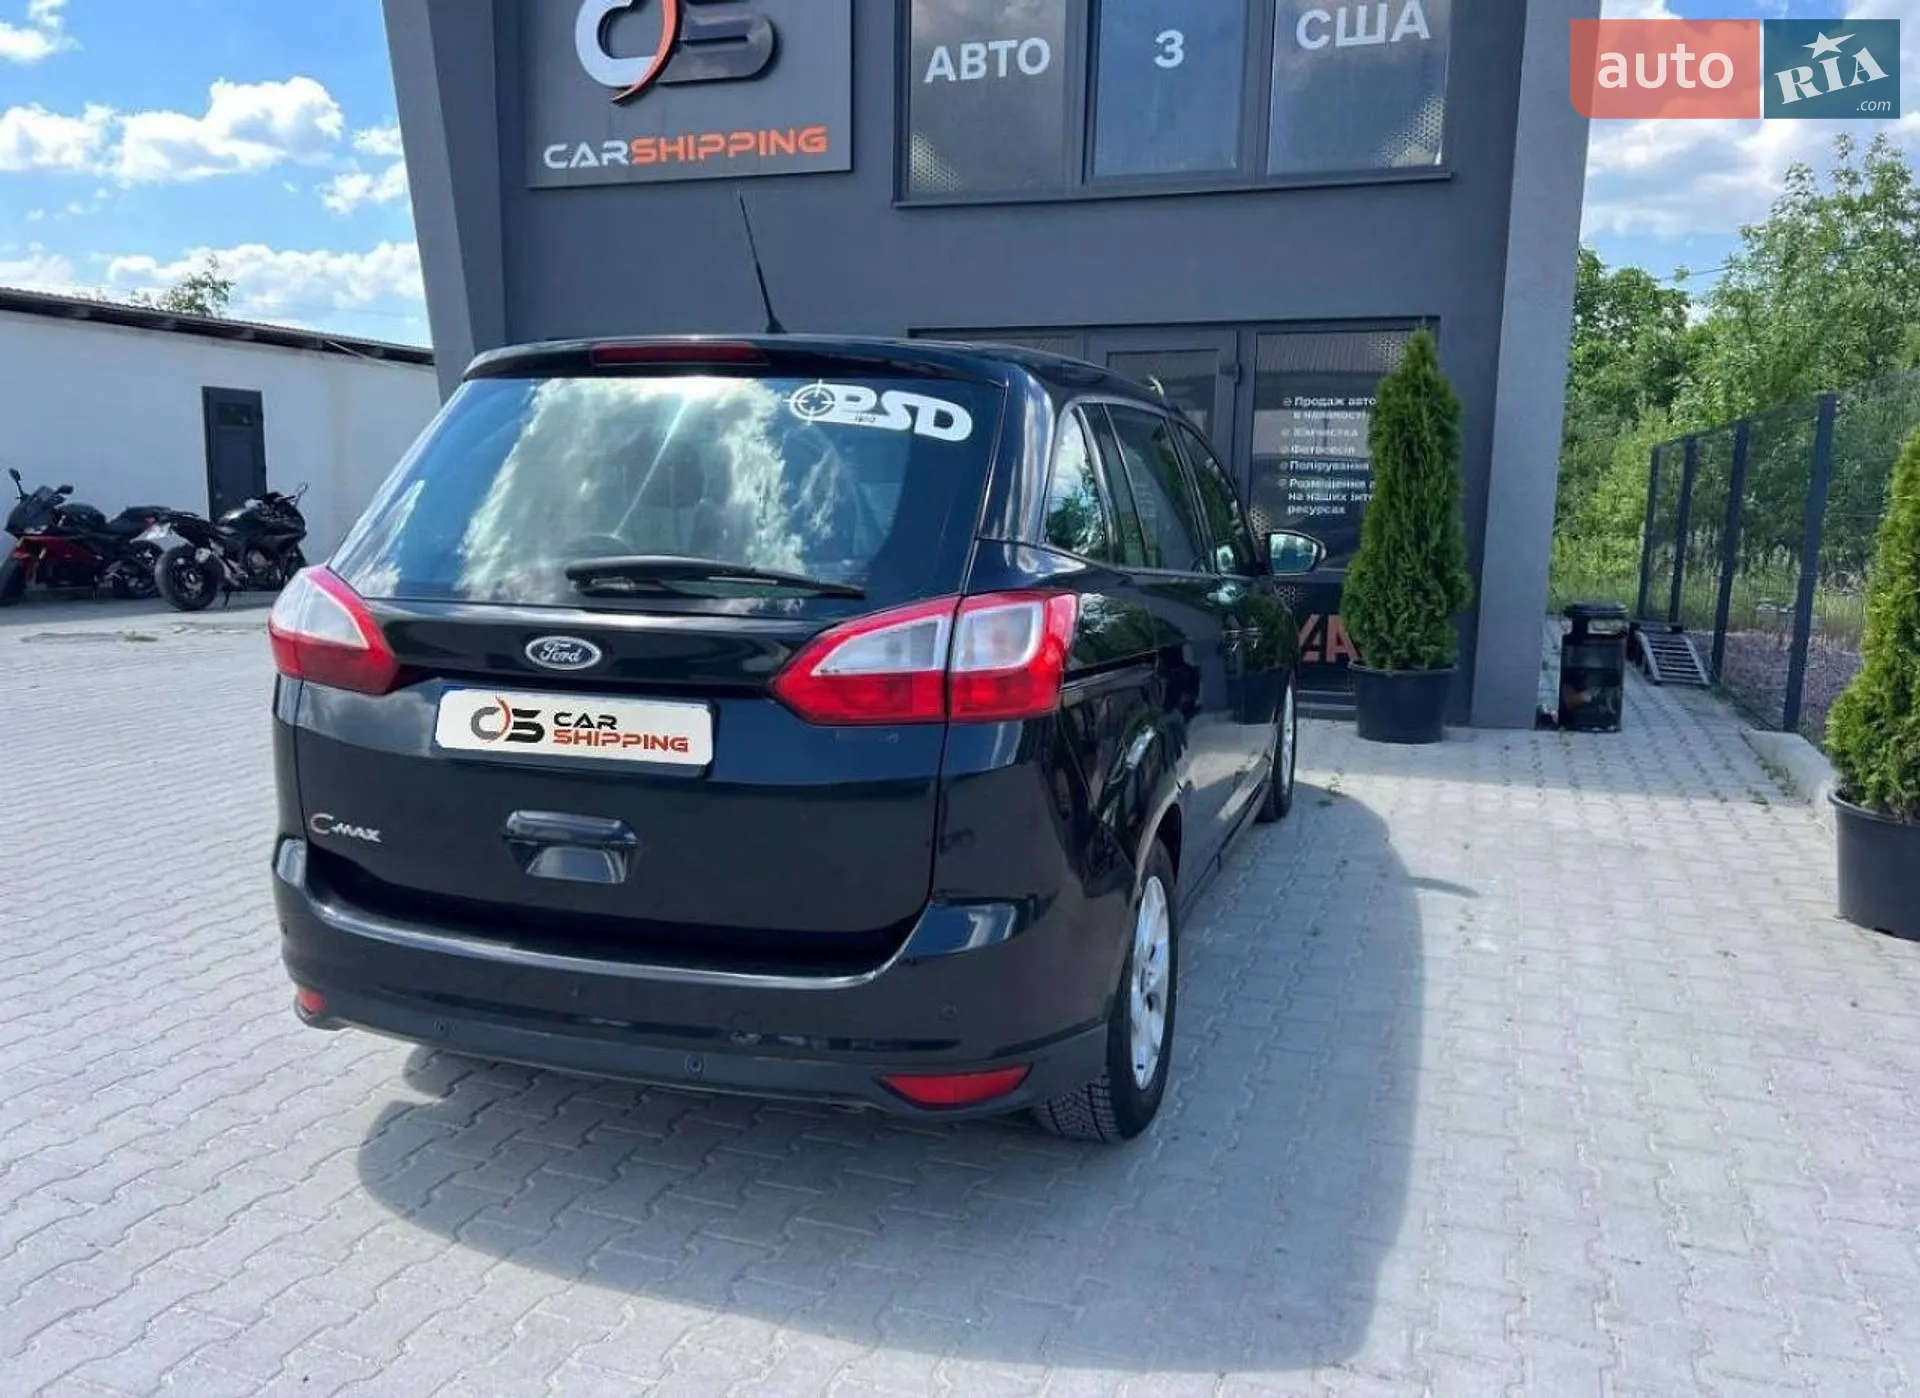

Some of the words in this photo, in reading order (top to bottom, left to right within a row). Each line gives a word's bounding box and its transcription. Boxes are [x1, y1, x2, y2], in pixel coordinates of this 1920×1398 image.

[924, 37, 1051, 84] АВТО
[1296, 1, 1431, 50] США
[1294, 396, 1345, 407] Продаж
[1348, 396, 1377, 406] авто
[539, 640, 584, 664] Ford
[553, 711, 618, 730] CAR
[552, 728, 690, 753] SHIPPING
